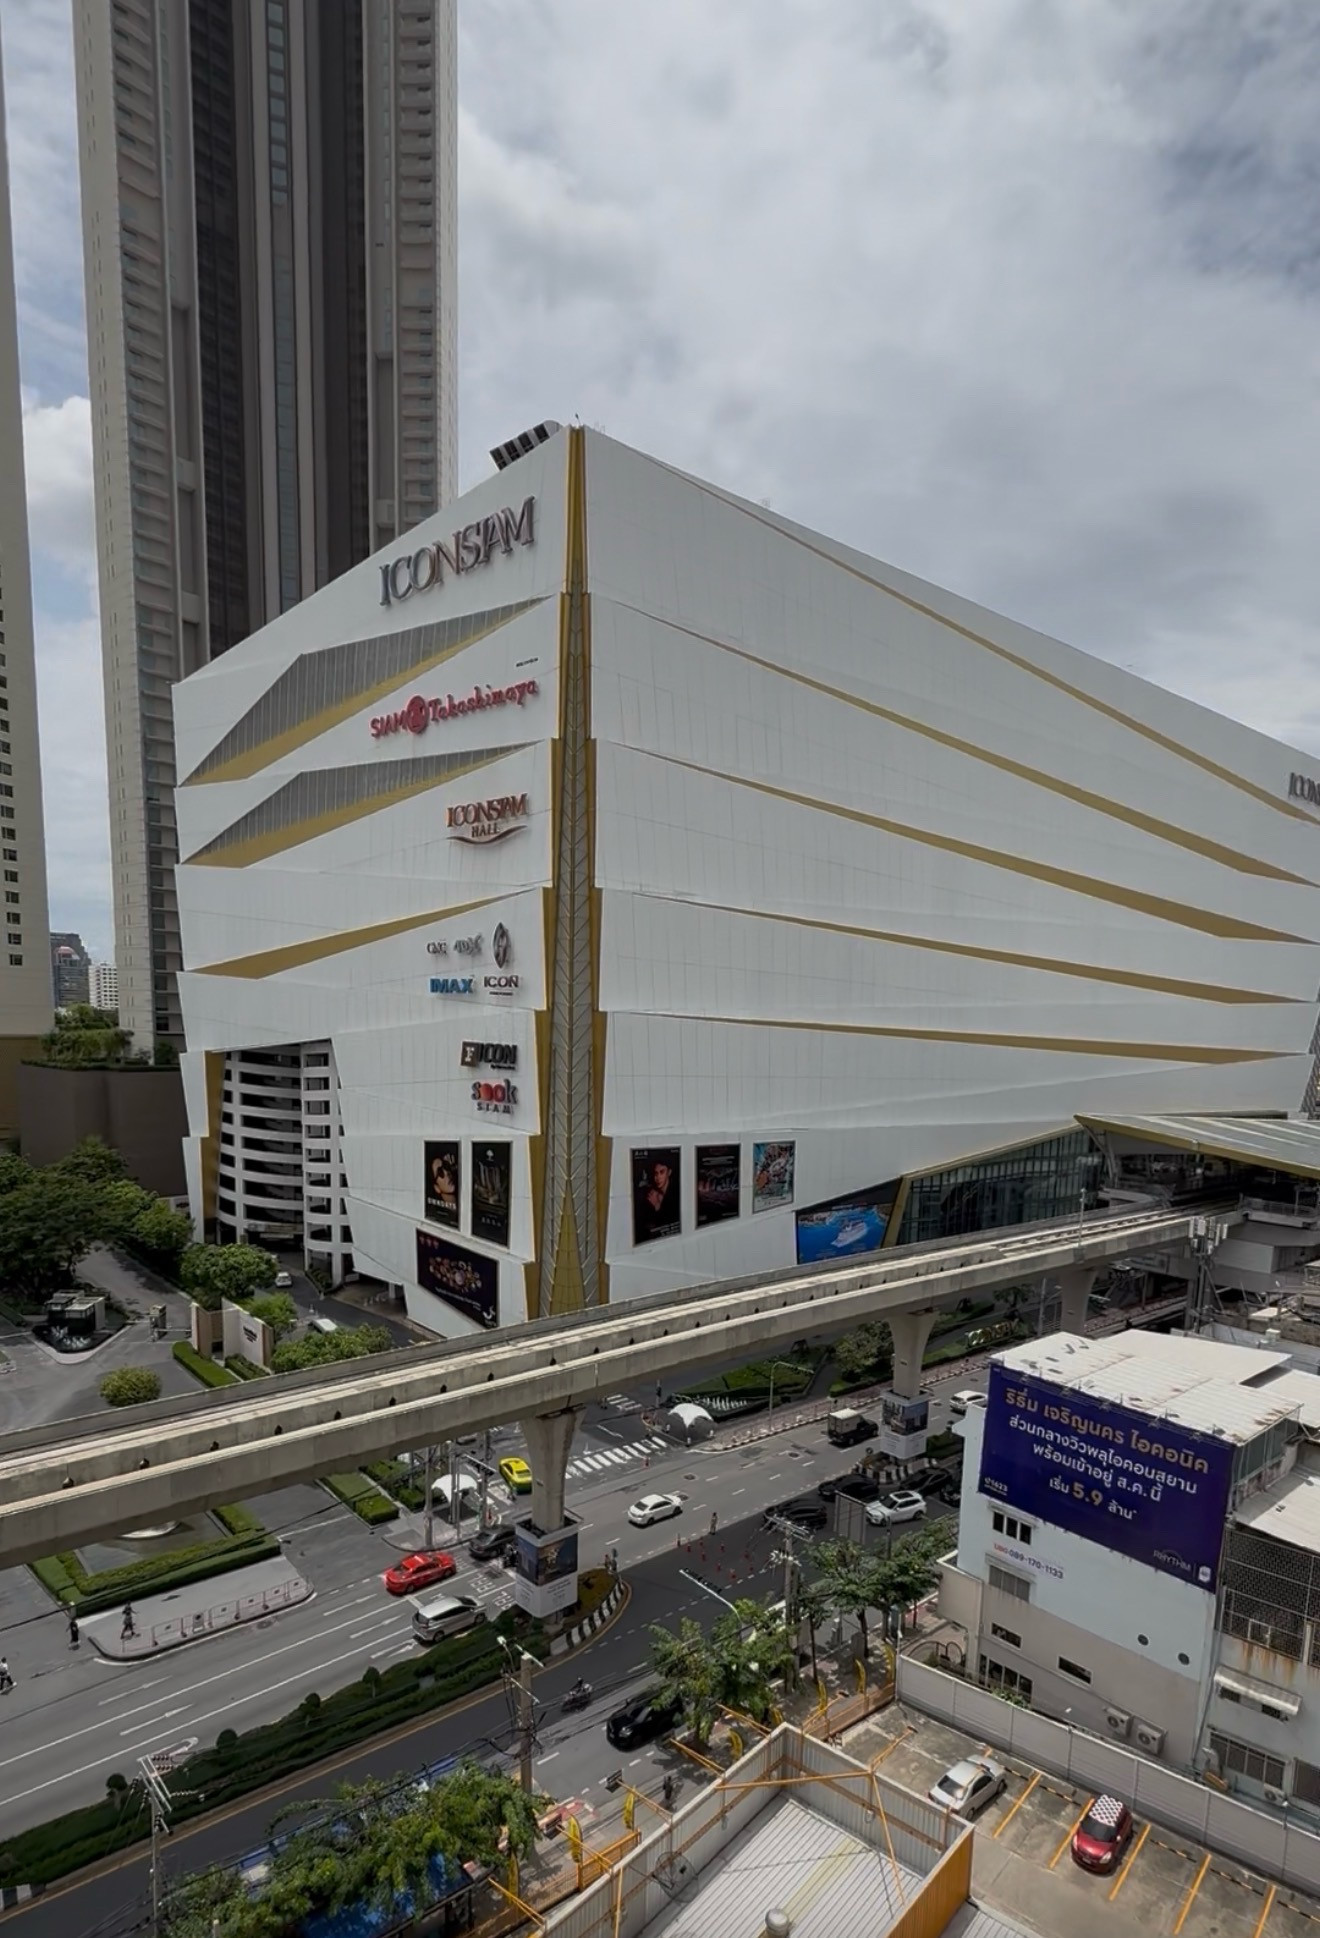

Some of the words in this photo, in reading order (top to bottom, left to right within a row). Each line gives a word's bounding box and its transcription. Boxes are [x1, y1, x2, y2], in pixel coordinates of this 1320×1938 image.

[379, 496, 535, 606] ICONSIAM
[371, 710, 407, 738] SIAM
[428, 680, 538, 722] Takashimaya
[447, 793, 528, 827] ICONSIAM
[471, 822, 500, 838] HALL
[430, 977, 474, 994] IMAX
[483, 975, 519, 988] ICON
[479, 1043, 518, 1064] ICON
[476, 1102, 512, 1114] SIAM
[1043, 1406, 1125, 1444] เจริญนคร
[1131, 1429, 1209, 1474] ไอคอนิค
[1033, 1443, 1114, 1488] พร้อมเข้าอยู่
[1117, 1477, 1148, 1497] ส.ค.
[1150, 1483, 1163, 1501] นี้
[1049, 1475, 1069, 1494] เริ่ม
[1073, 1482, 1103, 1506] 5.9
